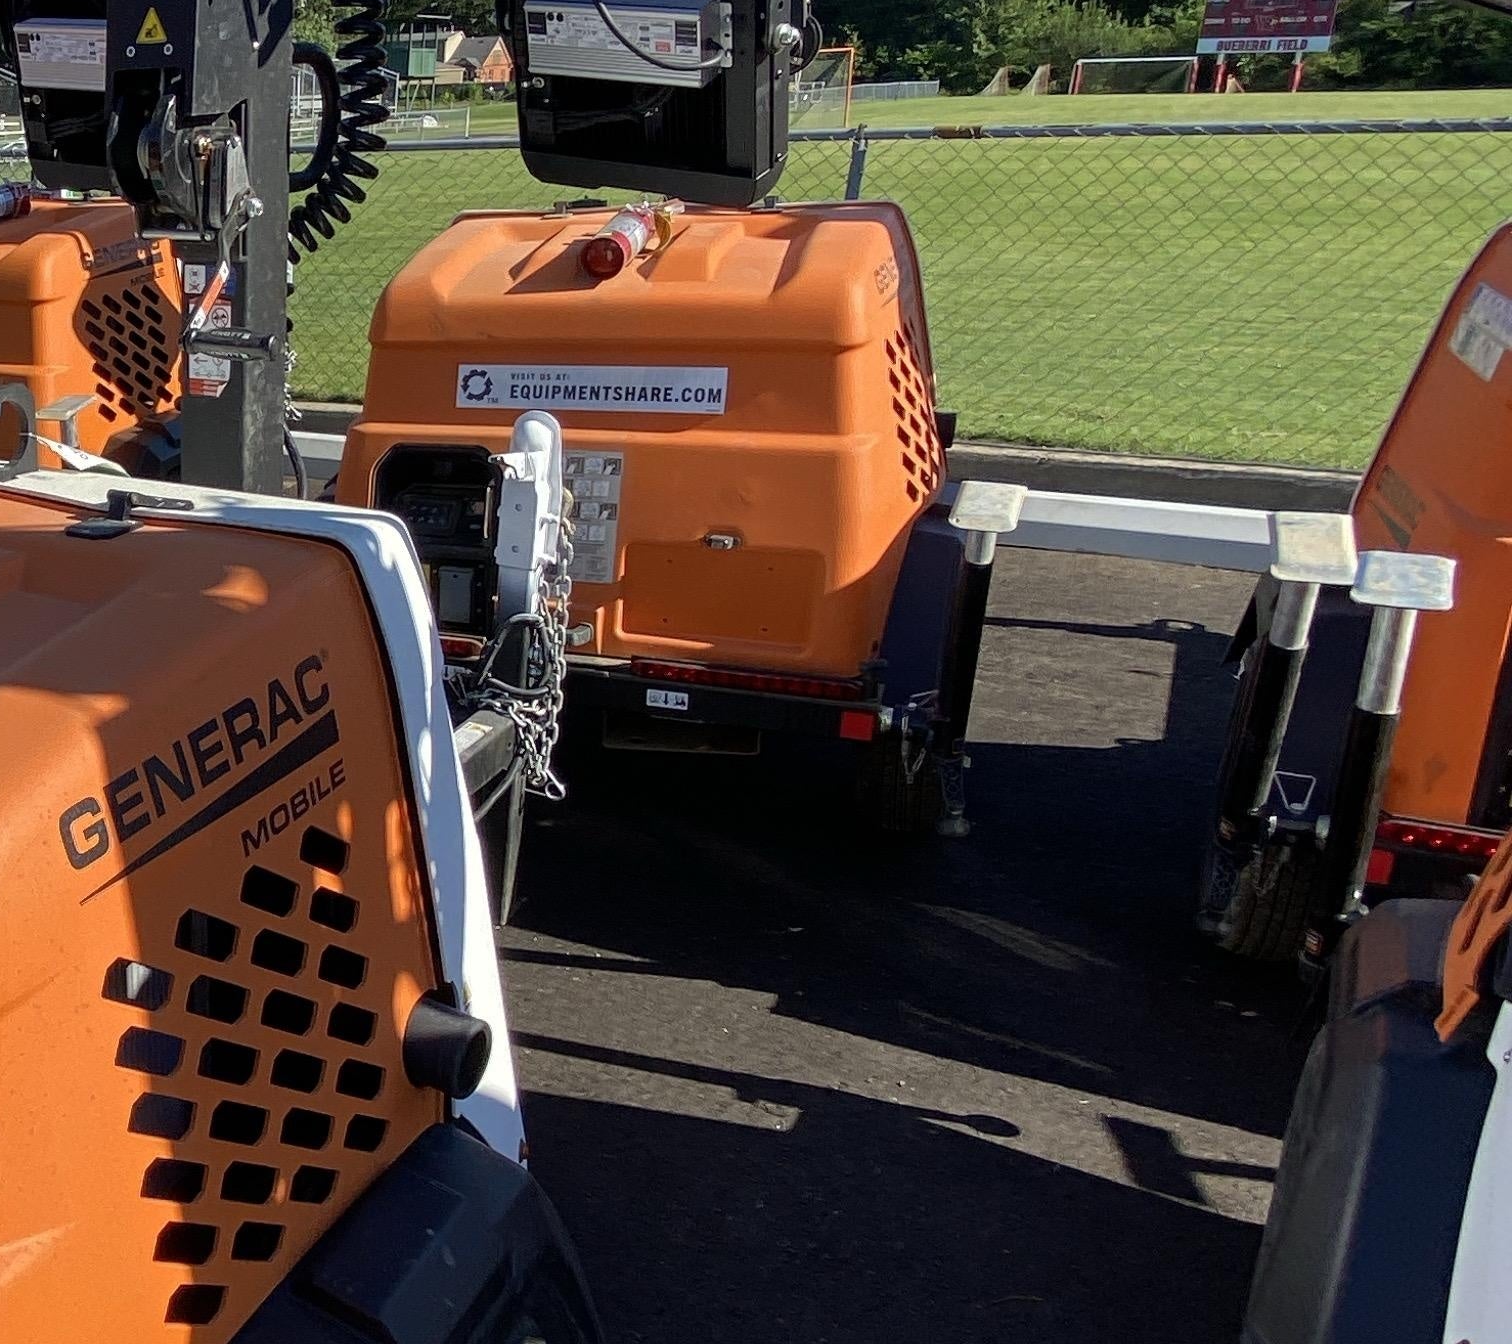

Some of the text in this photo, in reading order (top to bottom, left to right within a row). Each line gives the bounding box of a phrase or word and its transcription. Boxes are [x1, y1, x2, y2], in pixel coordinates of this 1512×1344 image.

[1276, 39, 1308, 51] FIELD
[509, 384, 722, 404] EQUIPMENTSHARE.COM
[58, 654, 331, 870] GENERAC
[240, 758, 346, 857] MOBILE
